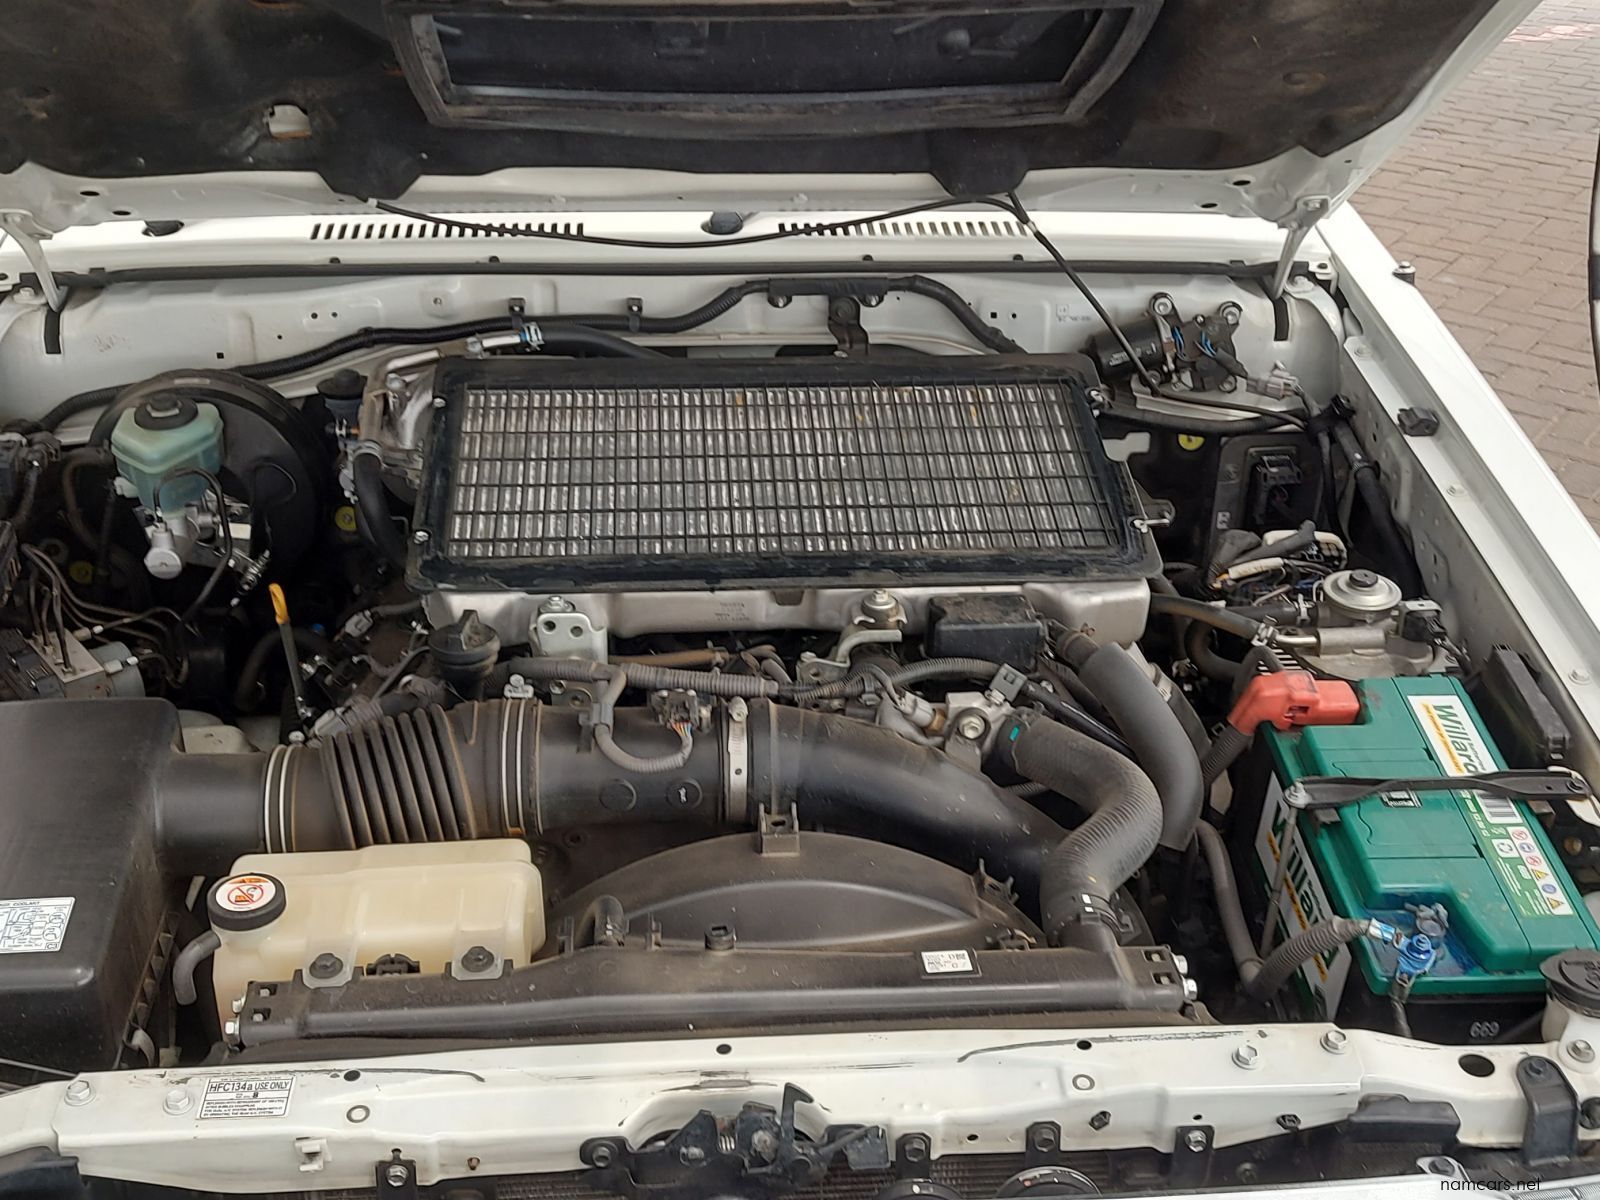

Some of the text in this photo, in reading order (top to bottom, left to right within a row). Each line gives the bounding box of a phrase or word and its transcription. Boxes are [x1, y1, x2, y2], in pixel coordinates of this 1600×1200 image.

[1470, 1021, 1499, 1037] 669
[209, 1081, 290, 1092] HFC134a USE ONLY
